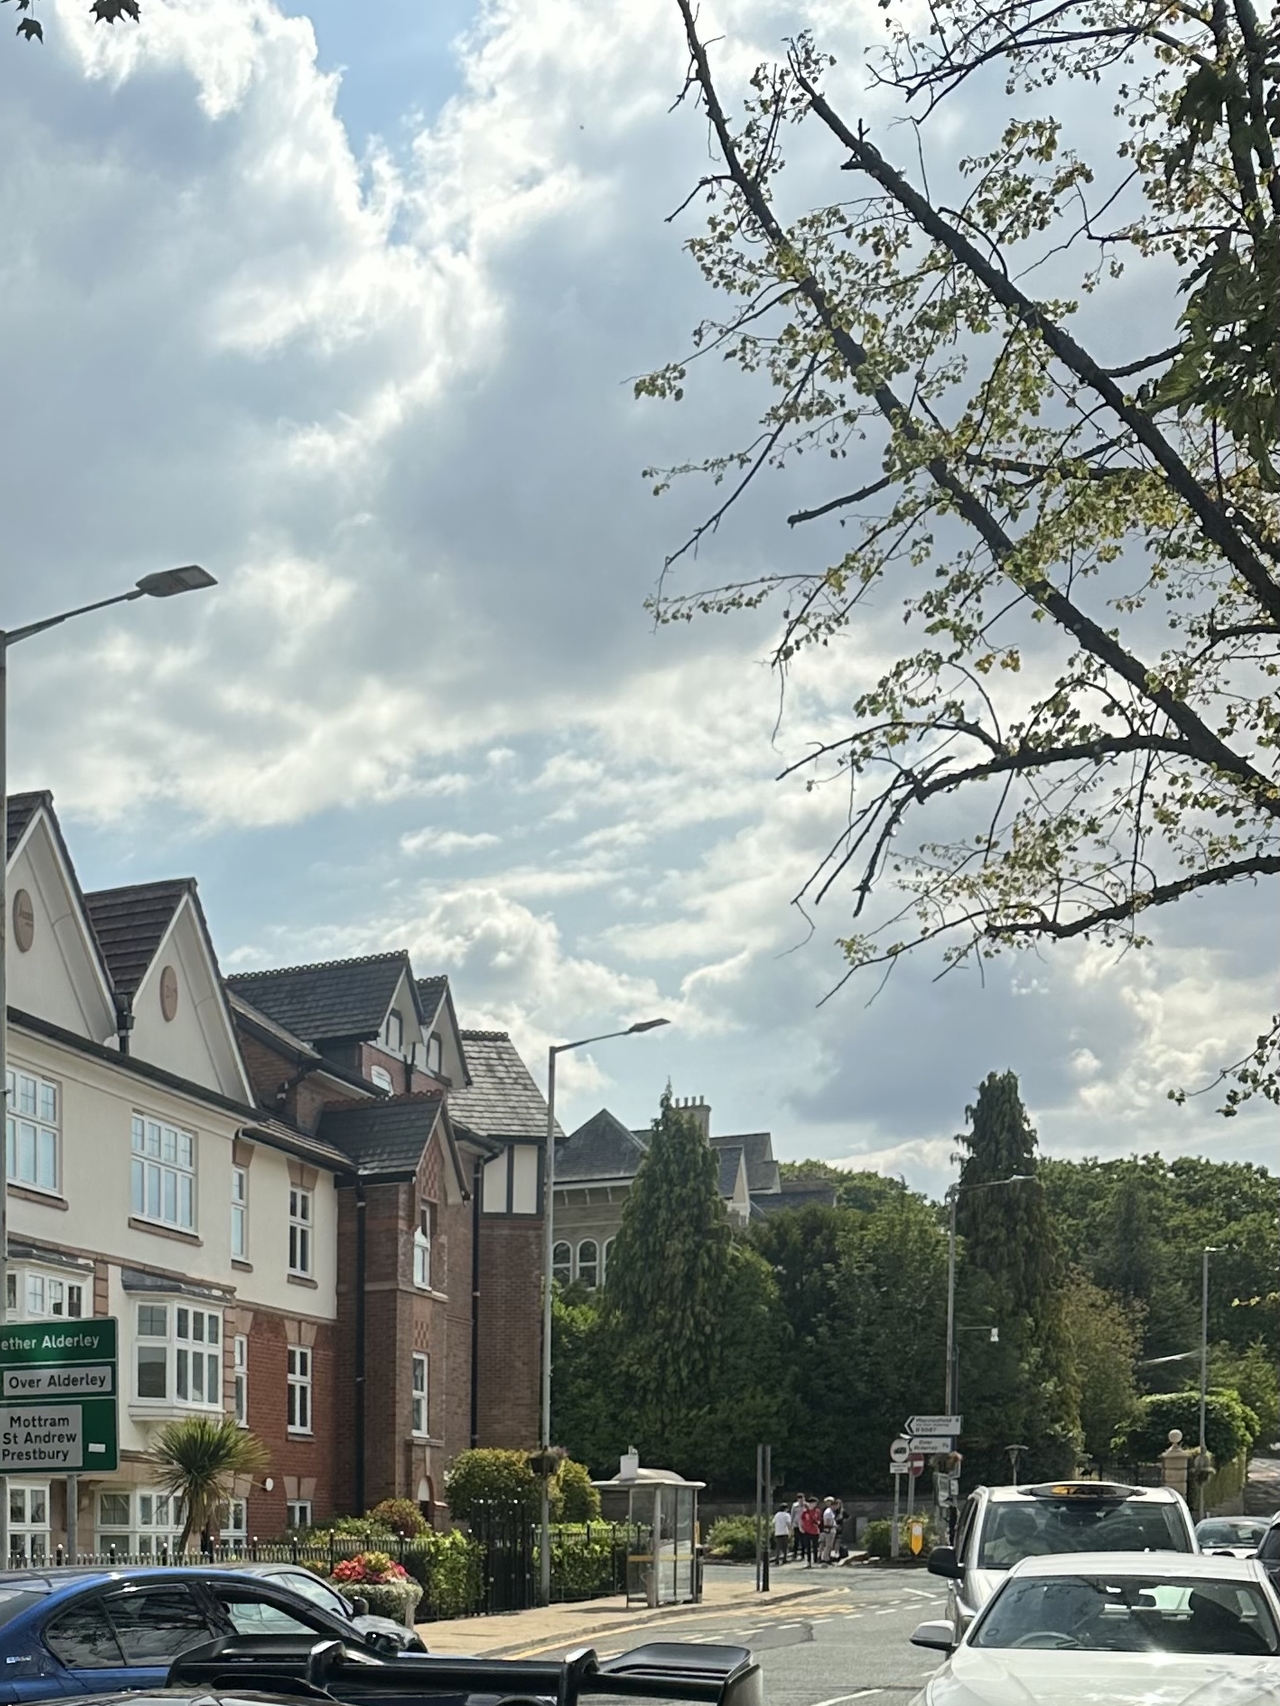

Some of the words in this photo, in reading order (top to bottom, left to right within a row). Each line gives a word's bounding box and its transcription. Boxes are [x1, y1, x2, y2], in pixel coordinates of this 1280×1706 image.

[42, 1333, 100, 1350] Alderley
[8, 1376, 42, 1389] Over
[47, 1373, 106, 1388] Alderley
[10, 1416, 69, 1428] Mottram
[2, 1432, 18, 1445] St
[24, 1430, 77, 1443] Andrew
[2, 1448, 69, 1462] Prestbury
